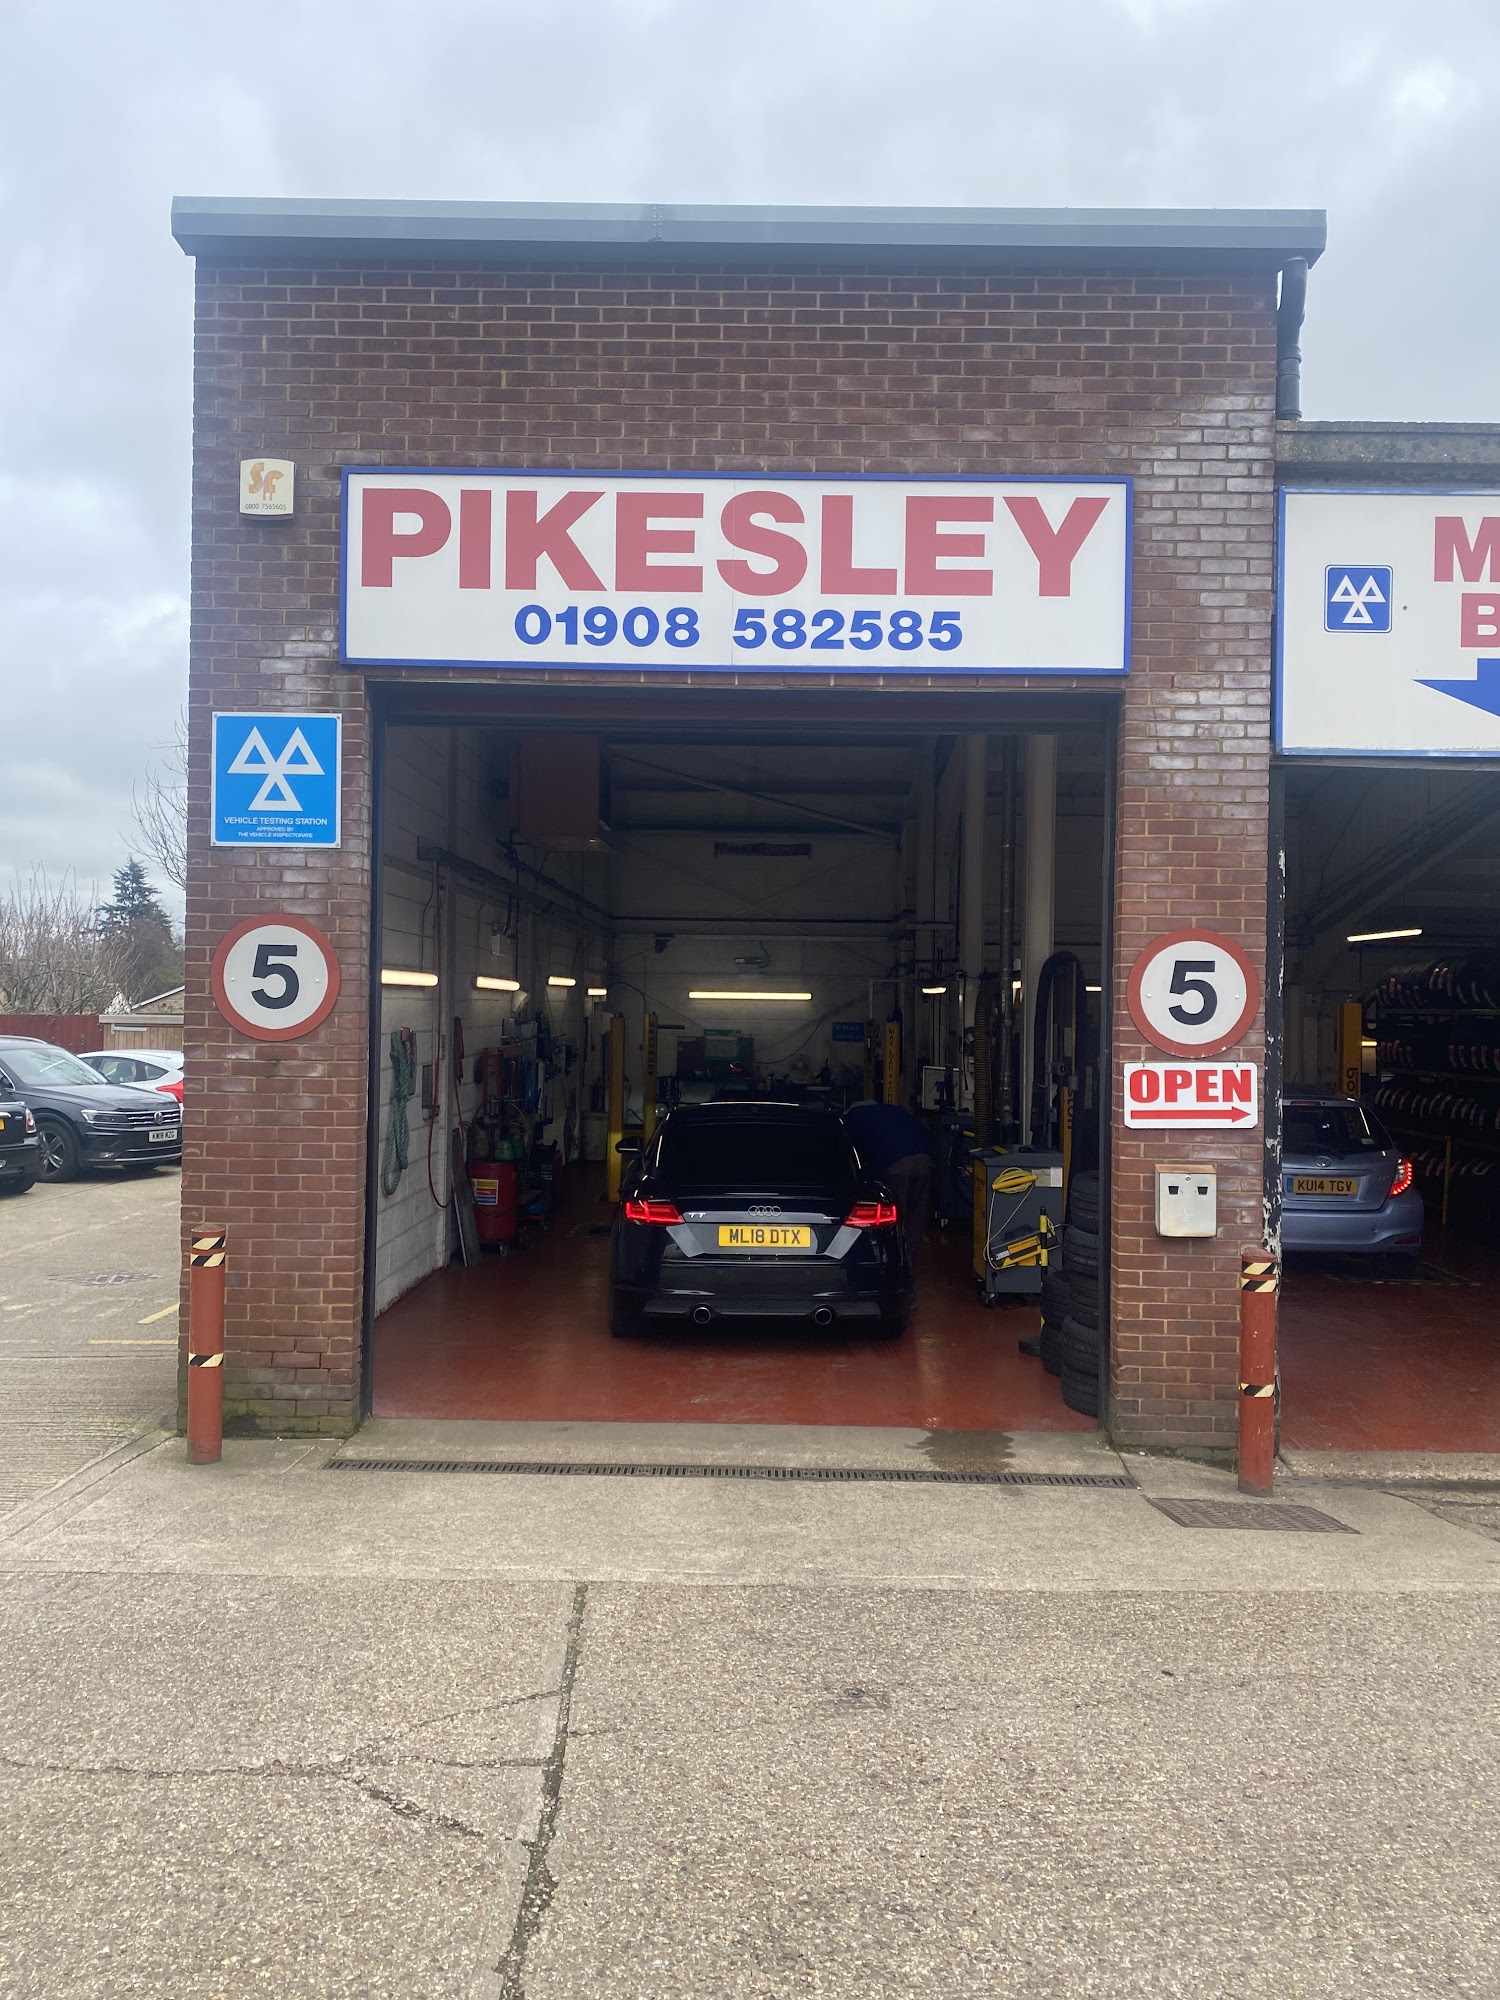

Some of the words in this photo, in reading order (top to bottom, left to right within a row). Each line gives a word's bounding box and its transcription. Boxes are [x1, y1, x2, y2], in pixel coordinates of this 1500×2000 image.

[361, 487, 1111, 597] PIKESLEY
[514, 604, 701, 648] 01908
[732, 608, 964, 651] 582585
[224, 817, 258, 825] VEHICLE
[260, 817, 294, 825] TESTING
[295, 818, 328, 826] STATION
[251, 944, 300, 1010] 5
[1168, 960, 1218, 1026] 5
[1129, 1069, 1251, 1103] OPEN
[1298, 1179, 1325, 1191] KU14
[1328, 1180, 1352, 1192] TGV
[729, 1228, 765, 1243] ML18
[769, 1229, 801, 1244] DTX
